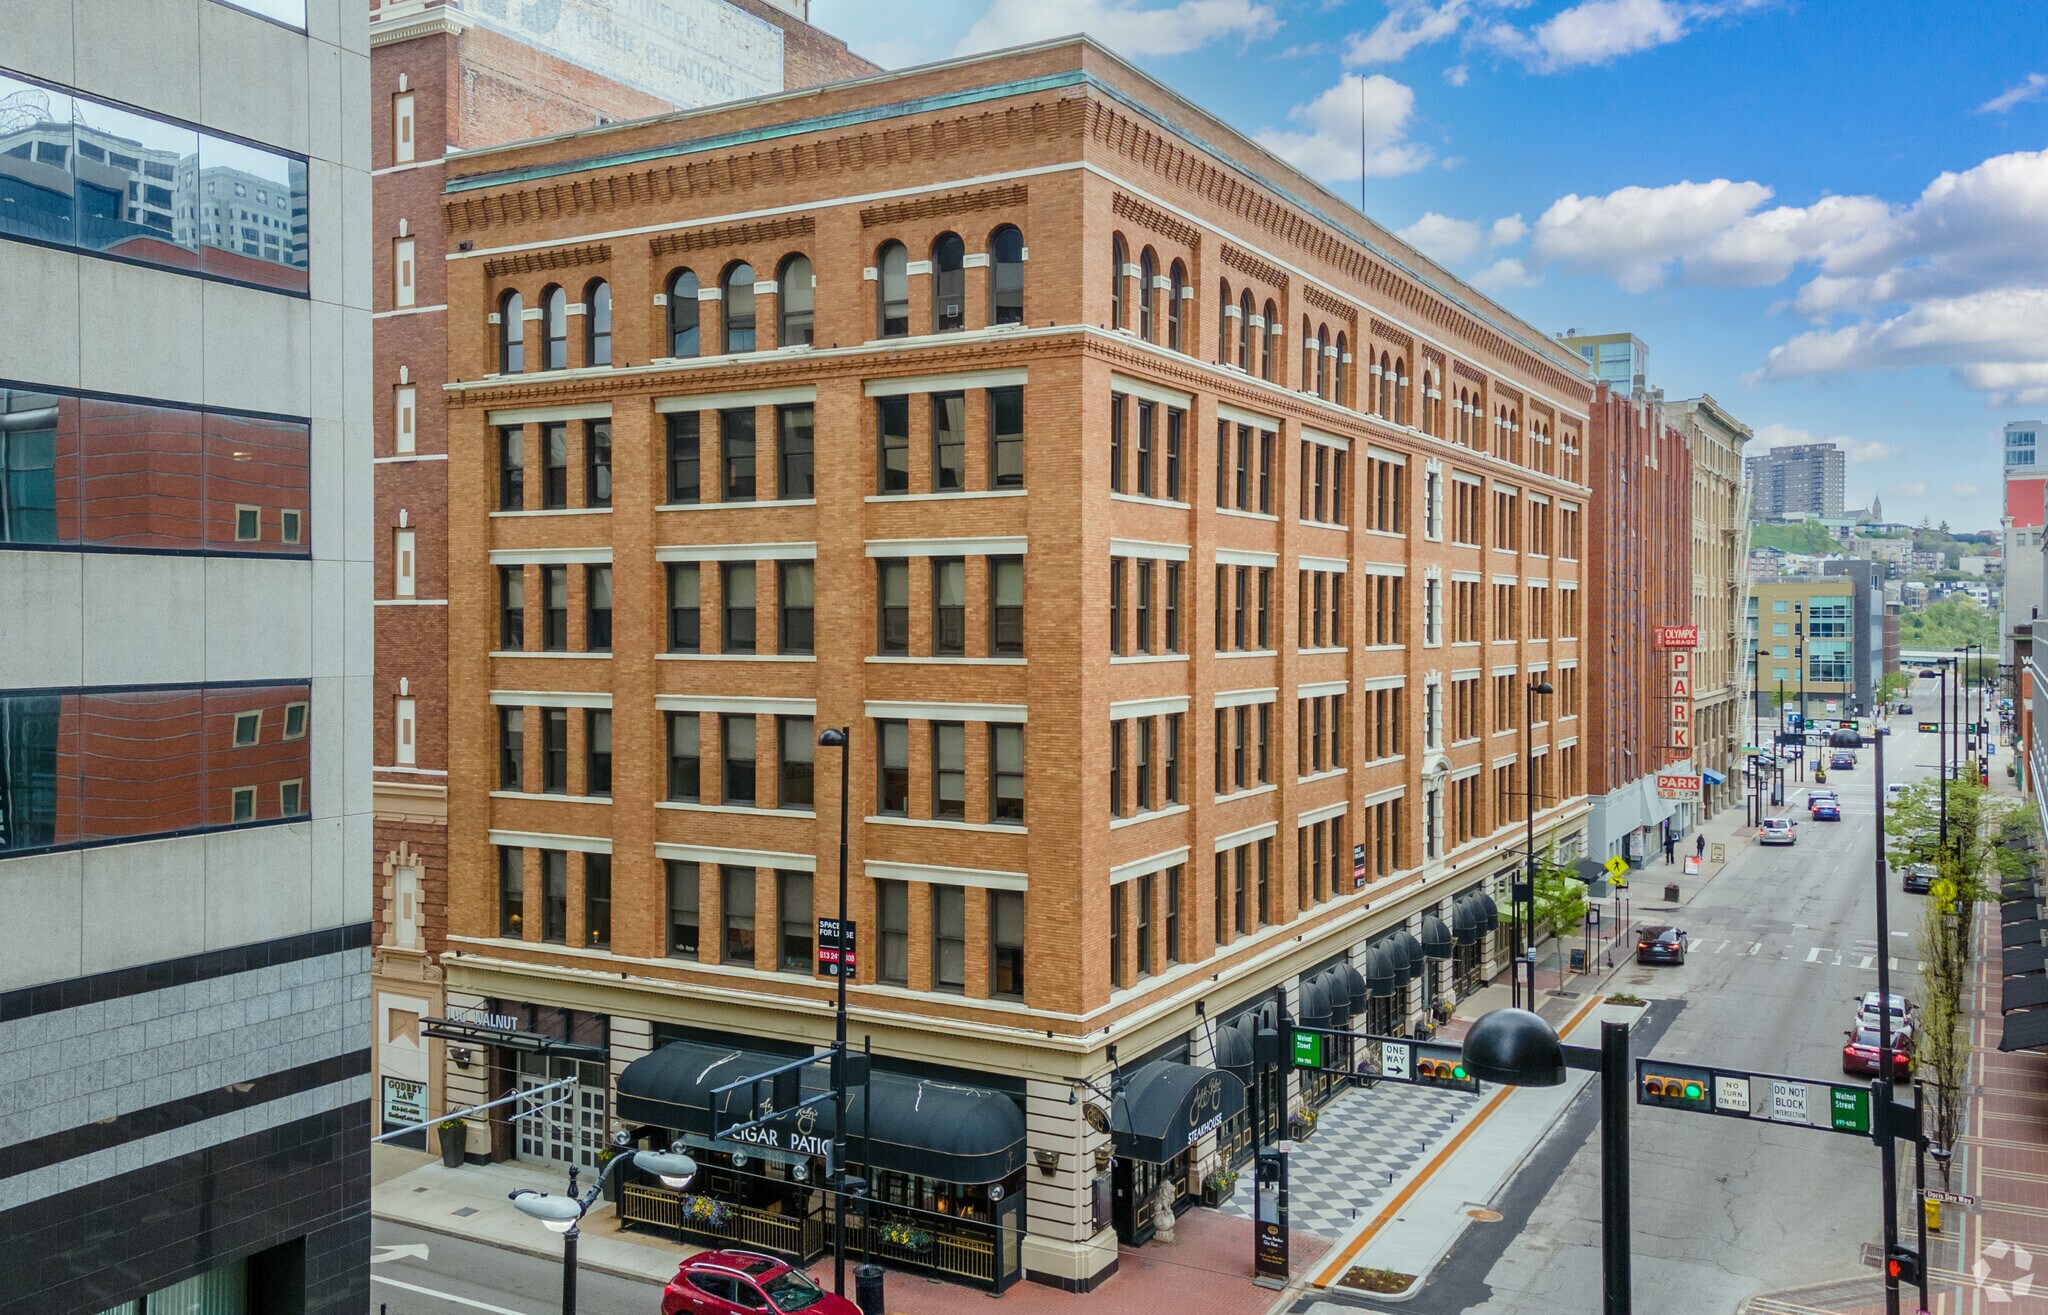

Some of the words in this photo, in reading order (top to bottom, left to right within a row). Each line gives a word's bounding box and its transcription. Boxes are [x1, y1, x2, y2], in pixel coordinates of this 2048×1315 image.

[646, 40, 735, 97] RELATIONS
[1665, 629, 1696, 639] OLYMPIC
[1659, 777, 1698, 789] PARK
[820, 929, 832, 937] FOR
[473, 1011, 518, 1031] WALNUT
[1386, 1045, 1405, 1055] ONE
[1386, 1055, 1406, 1064] WAY
[388, 1080, 423, 1095] GODBEY
[1774, 1085, 1786, 1095] DO
[1788, 1087, 1805, 1098] NOT
[396, 1090, 415, 1101] LAW
[1722, 1089, 1743, 1098] TURN
[1835, 1091, 1857, 1101] Walnut
[1732, 1099, 1748, 1107] RED
[1775, 1097, 1804, 1109] BLOCK
[1835, 1100, 1855, 1110] Street
[1775, 1109, 1806, 1119] INTERSECTION
[1187, 1112, 1223, 1145] STEAKHOUSE
[731, 1123, 779, 1147] CIGAR
[1927, 1190, 1944, 1200] Doris
[1945, 1193, 1957, 1202] Day
[1958, 1196, 1972, 1204] Way
